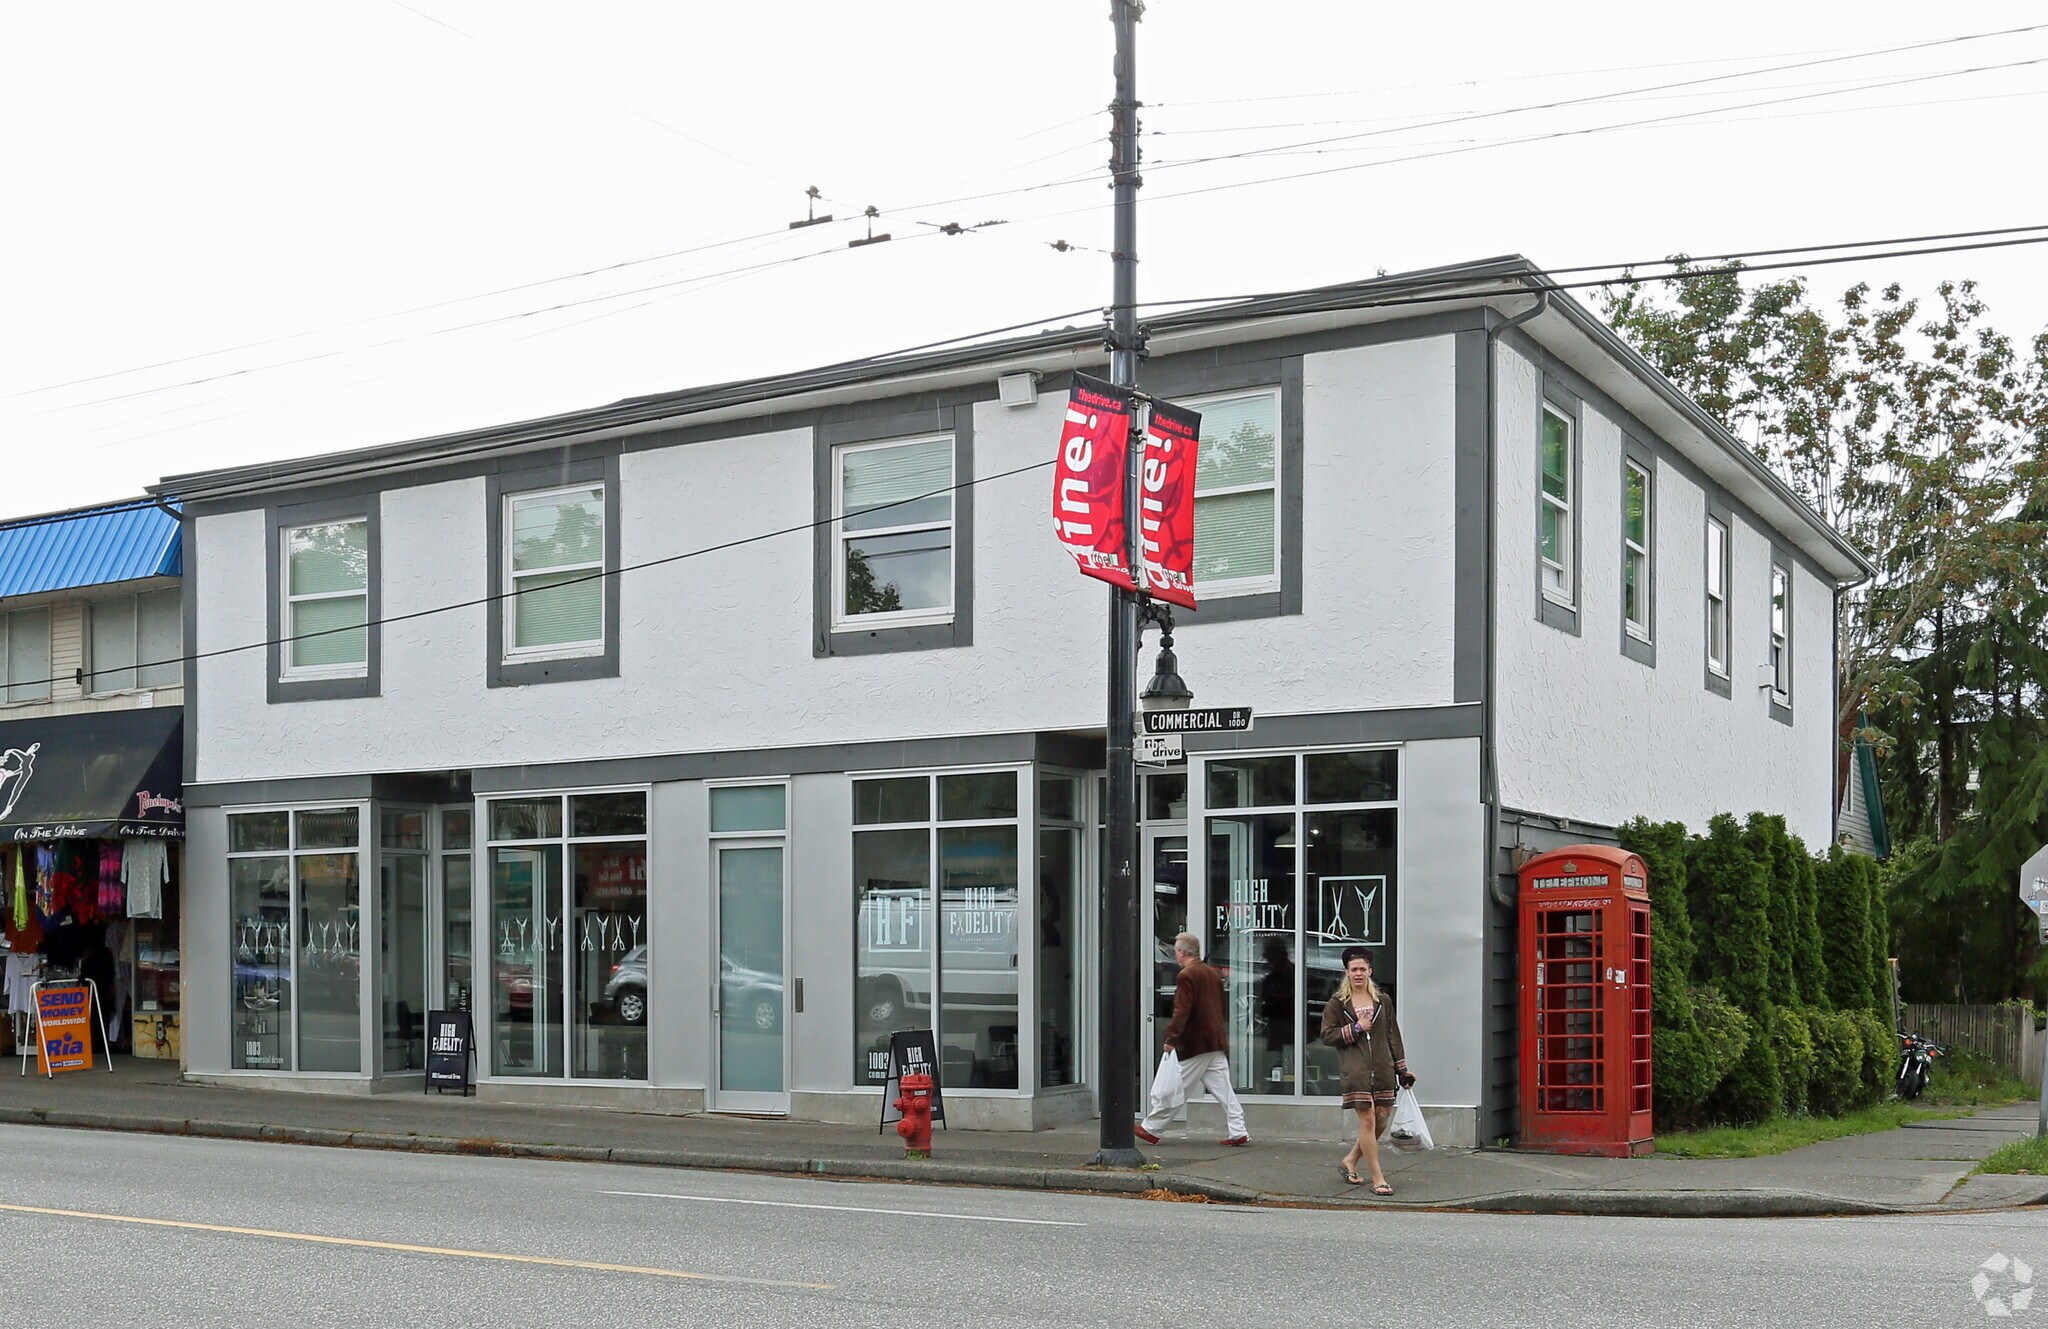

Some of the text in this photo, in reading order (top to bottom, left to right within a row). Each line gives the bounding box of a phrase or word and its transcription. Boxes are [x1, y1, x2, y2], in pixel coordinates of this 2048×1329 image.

[1078, 388, 1122, 411] thedrive.ca
[1155, 413, 1193, 436] thedrive.ca
[1151, 712, 1222, 730] COMMERCIAL
[1233, 711, 1241, 719] DR
[1229, 719, 1246, 727] 1000
[1145, 738, 1165, 749] the
[1152, 747, 1181, 757] drive
[14, 827, 28, 840] ON
[29, 826, 53, 839] THE
[120, 825, 134, 835] ON
[136, 825, 157, 836] THE
[1535, 876, 1608, 888] TELEPHONE
[964, 887, 995, 909] HIGH
[1233, 879, 1268, 903] HIGH
[41, 992, 85, 1007] SEND
[41, 1006, 84, 1018] MONEY
[41, 1017, 86, 1027] WORLDWIDE
[440, 1023, 456, 1037] HIGH
[46, 1032, 83, 1057] Ria
[246, 1041, 261, 1056] 1003
[868, 1052, 890, 1070] 1003
[906, 1046, 924, 1063] HIGH
